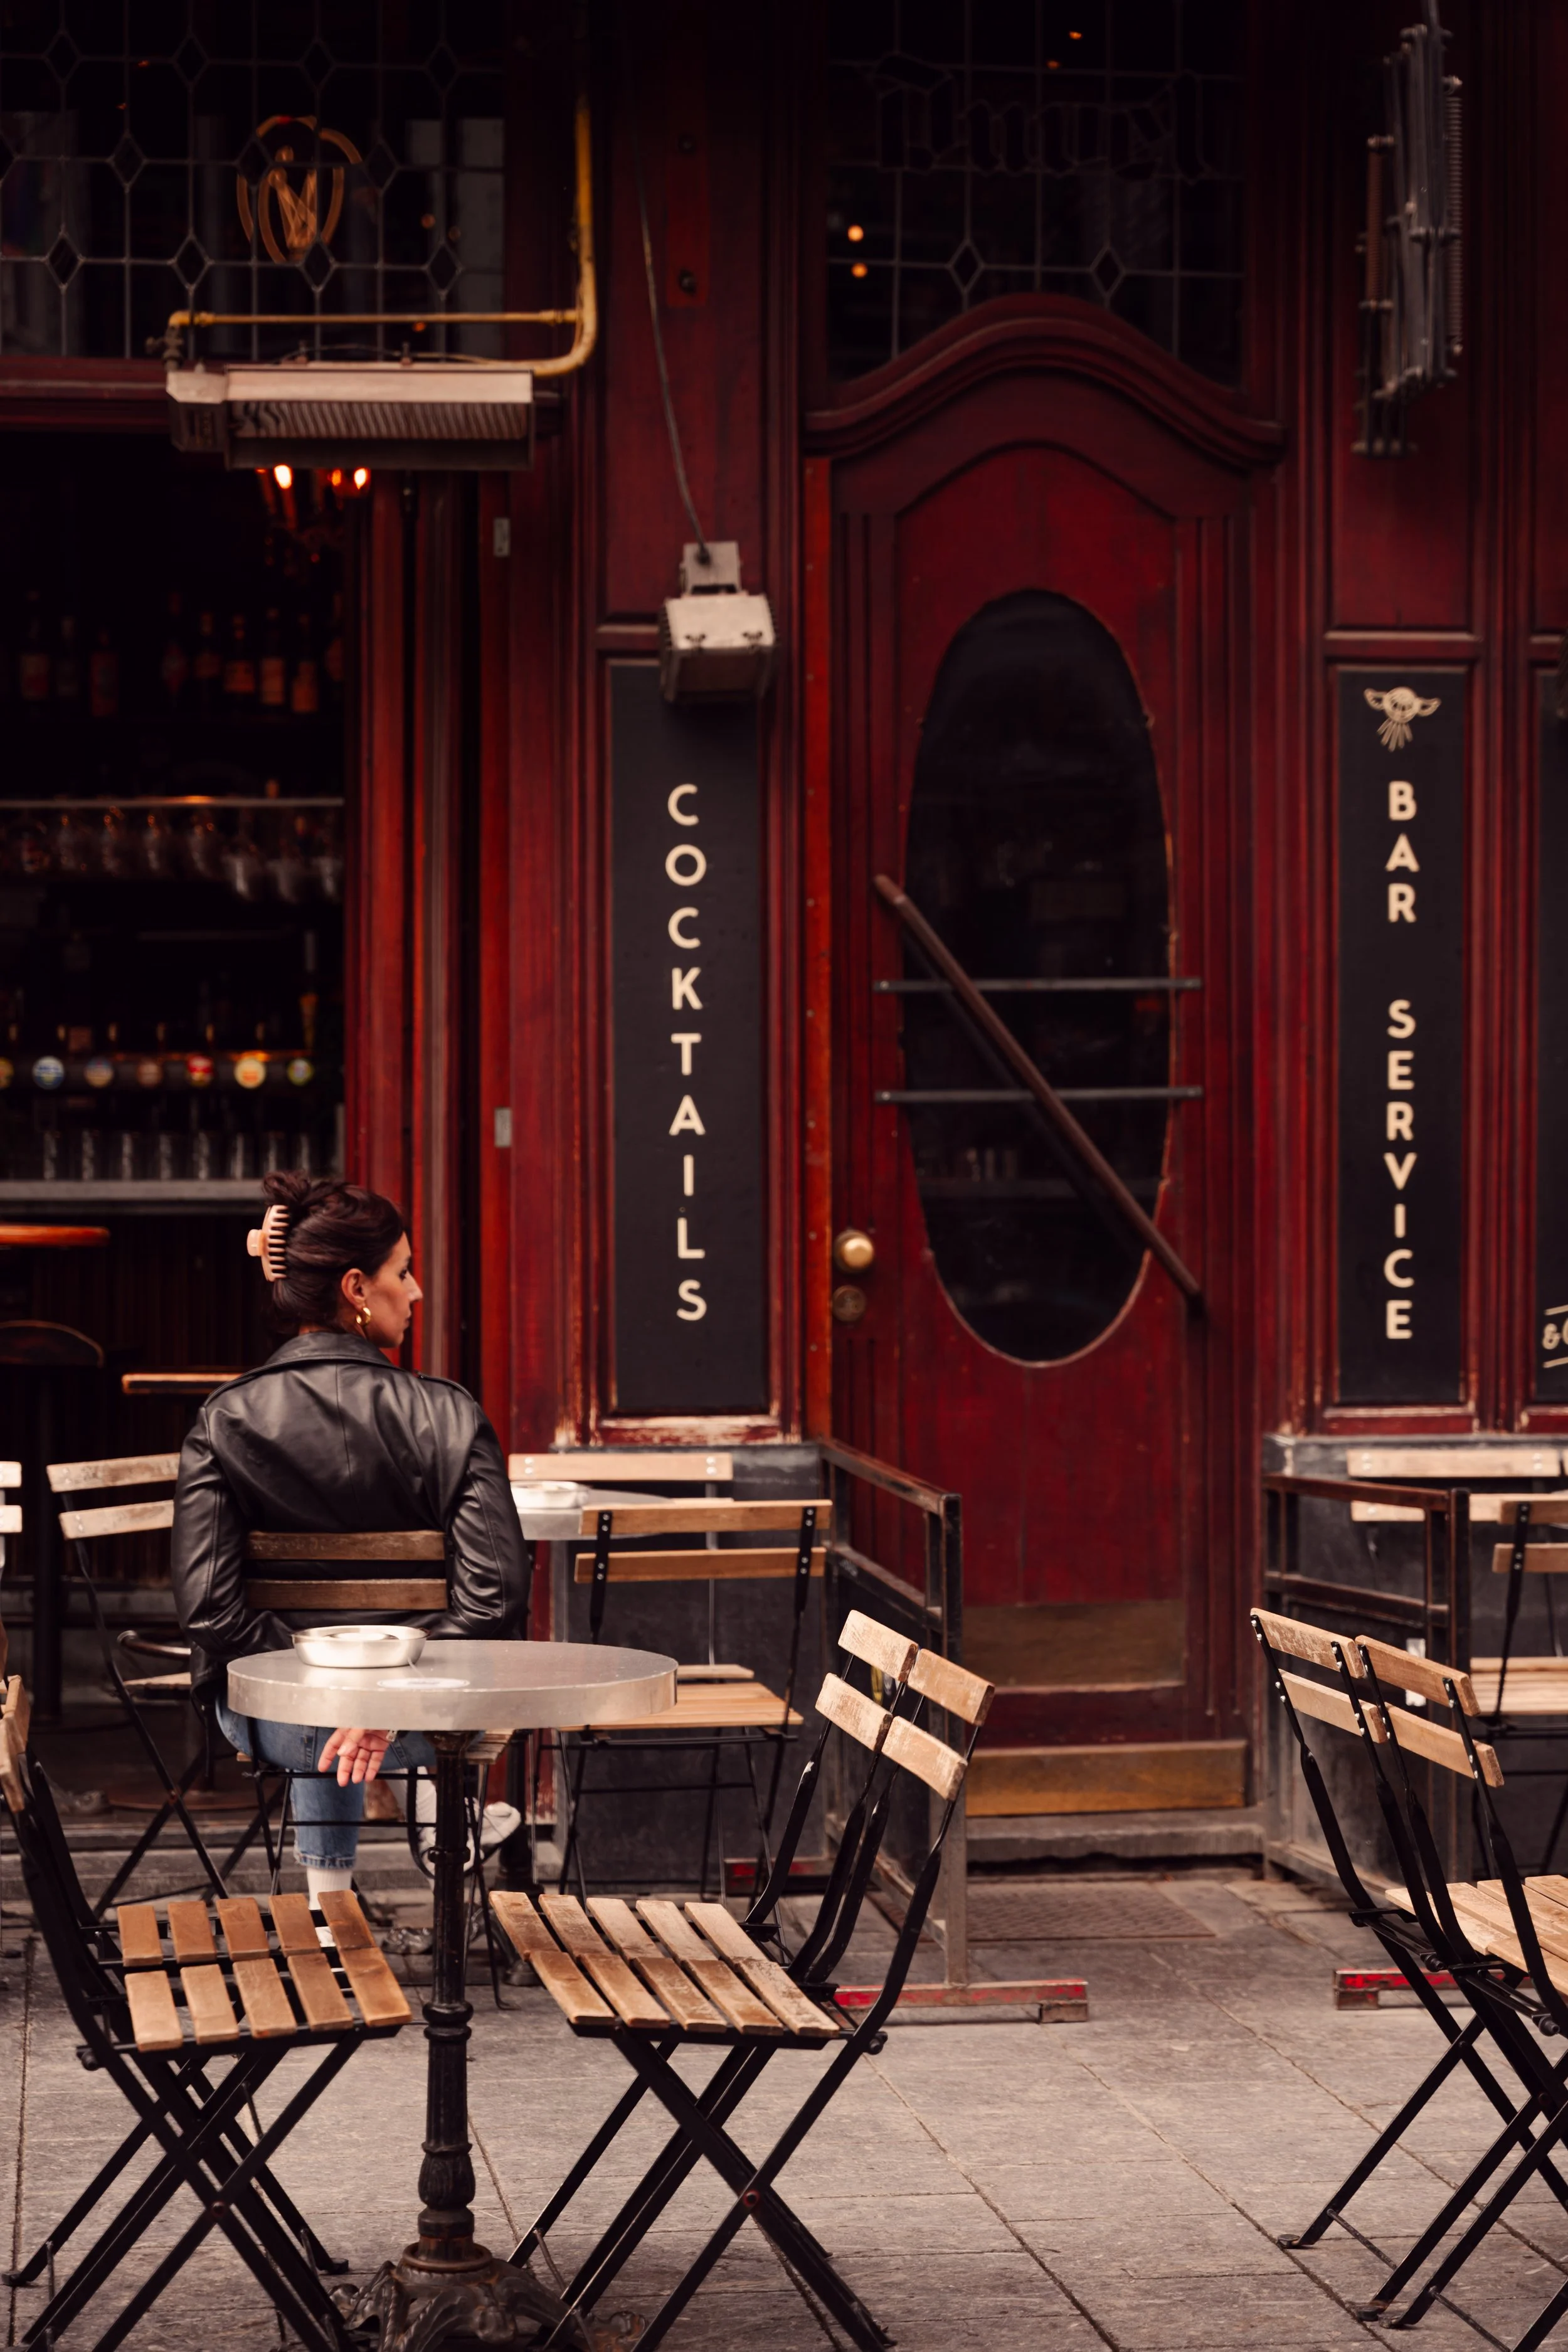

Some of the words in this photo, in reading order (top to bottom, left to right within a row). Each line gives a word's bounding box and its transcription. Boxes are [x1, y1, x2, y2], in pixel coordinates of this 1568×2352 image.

[1385, 780, 1419, 923] BAR
[665, 783, 707, 1322] COCKTAILS
[1384, 999, 1417, 1340] SERVICE
